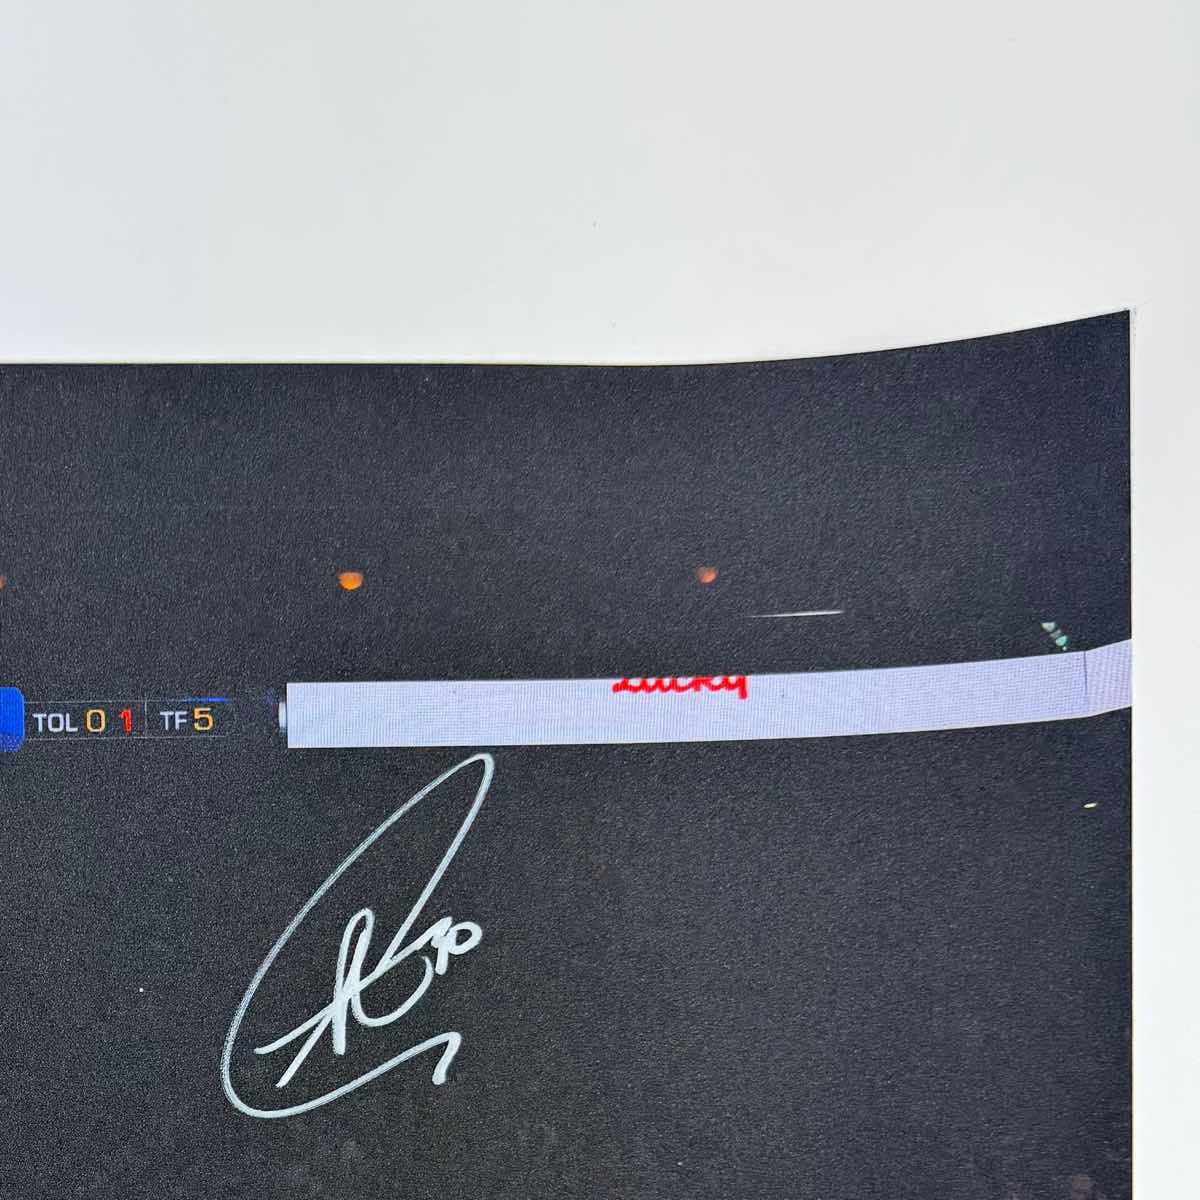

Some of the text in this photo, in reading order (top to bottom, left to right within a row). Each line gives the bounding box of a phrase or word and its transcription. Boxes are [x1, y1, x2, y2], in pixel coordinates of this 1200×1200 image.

[33, 708, 133, 733] TOL 0 1
[159, 706, 215, 732] TF 5
